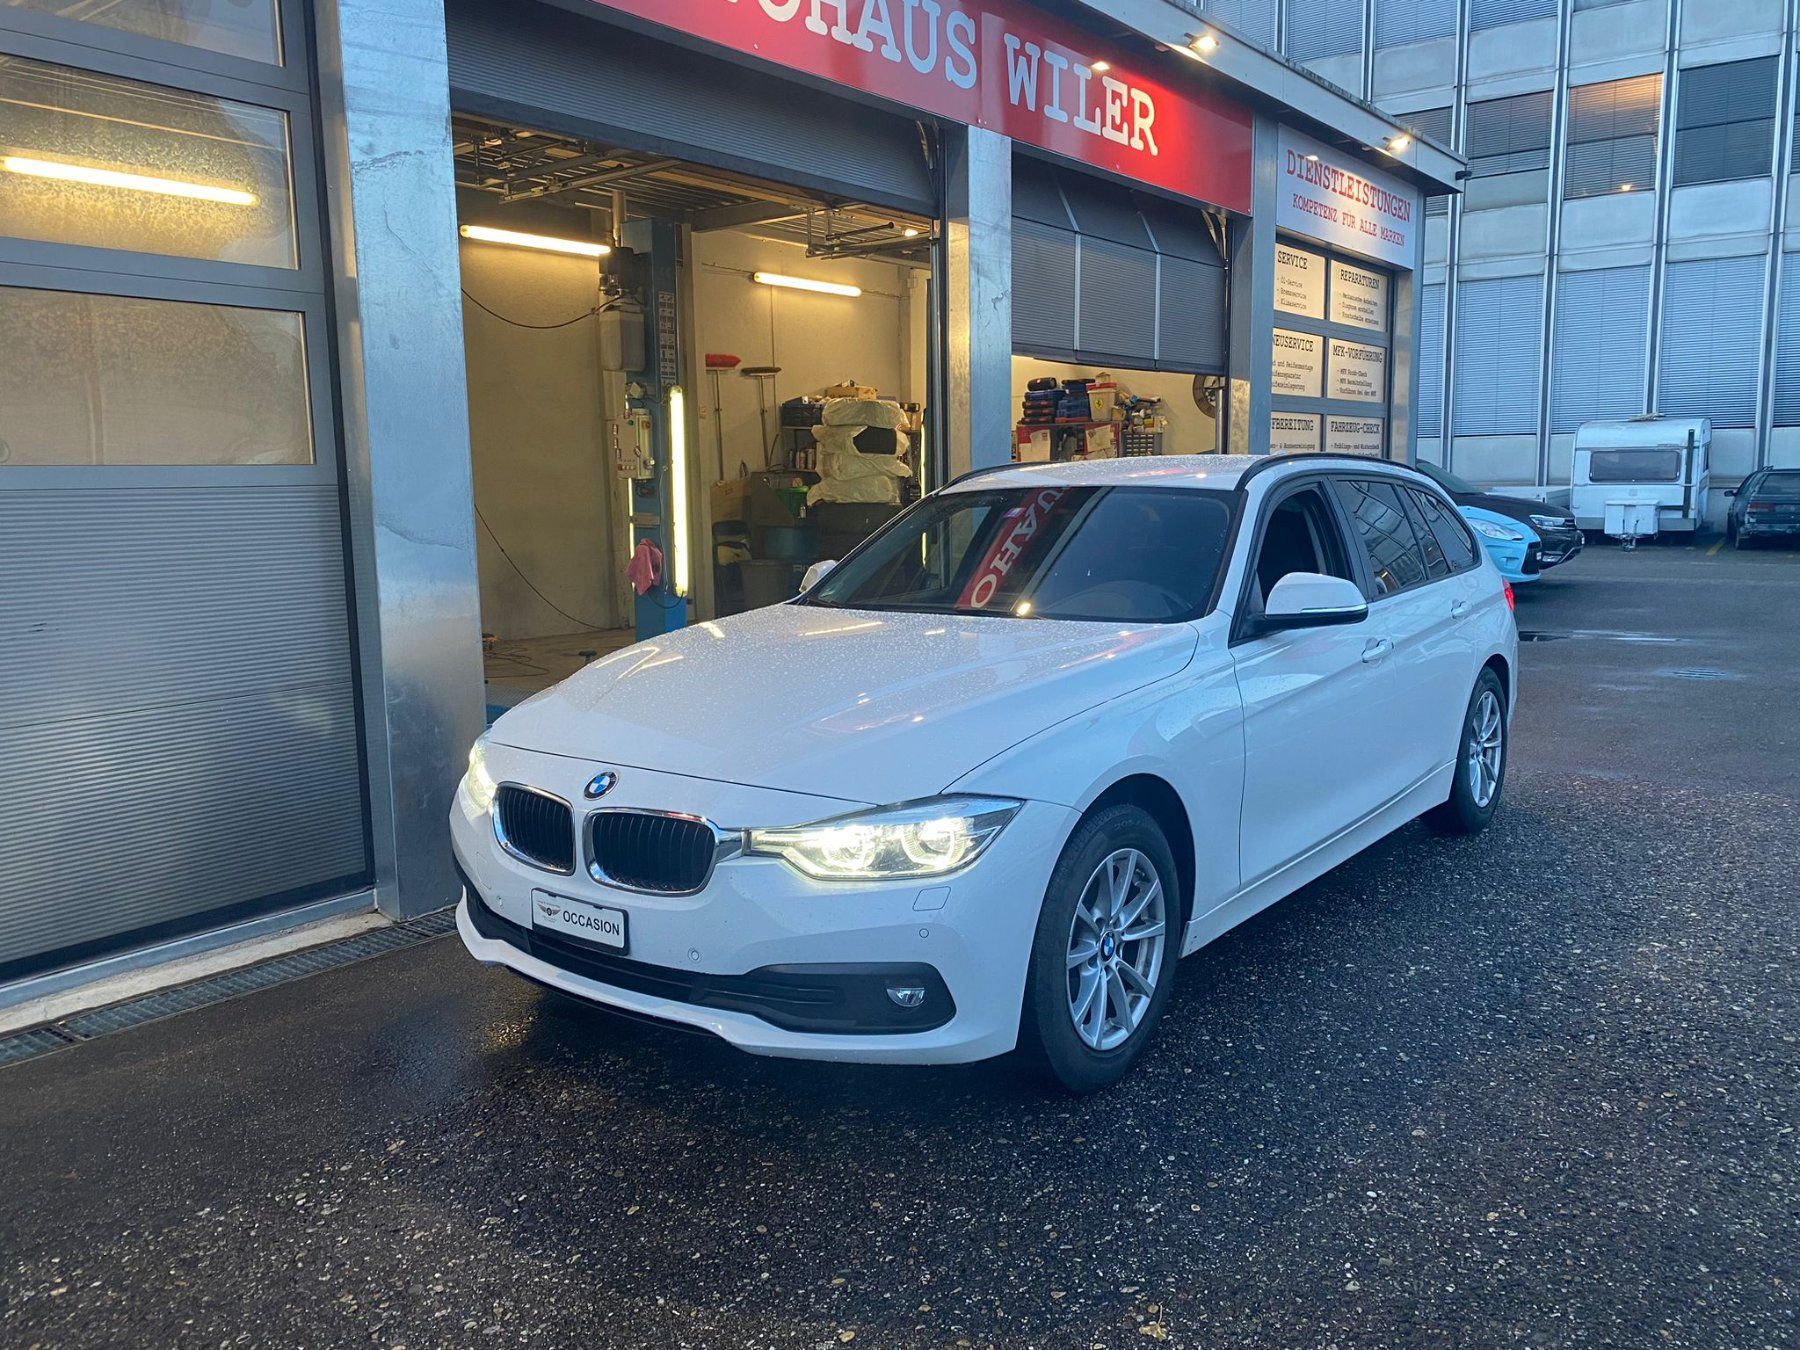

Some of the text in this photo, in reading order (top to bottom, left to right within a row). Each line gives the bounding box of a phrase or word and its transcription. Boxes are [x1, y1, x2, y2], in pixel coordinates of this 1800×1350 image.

[1003, 32, 1159, 157] WILER
[1286, 149, 1411, 223] DIENSTLEISTUNGEN
[1292, 192, 1338, 223] KOMPETENZ
[1359, 218, 1377, 237] ALLE
[1277, 250, 1308, 270] SERVICE
[1340, 268, 1380, 290] REPARATUREN
[563, 910, 620, 936] OCCASION
